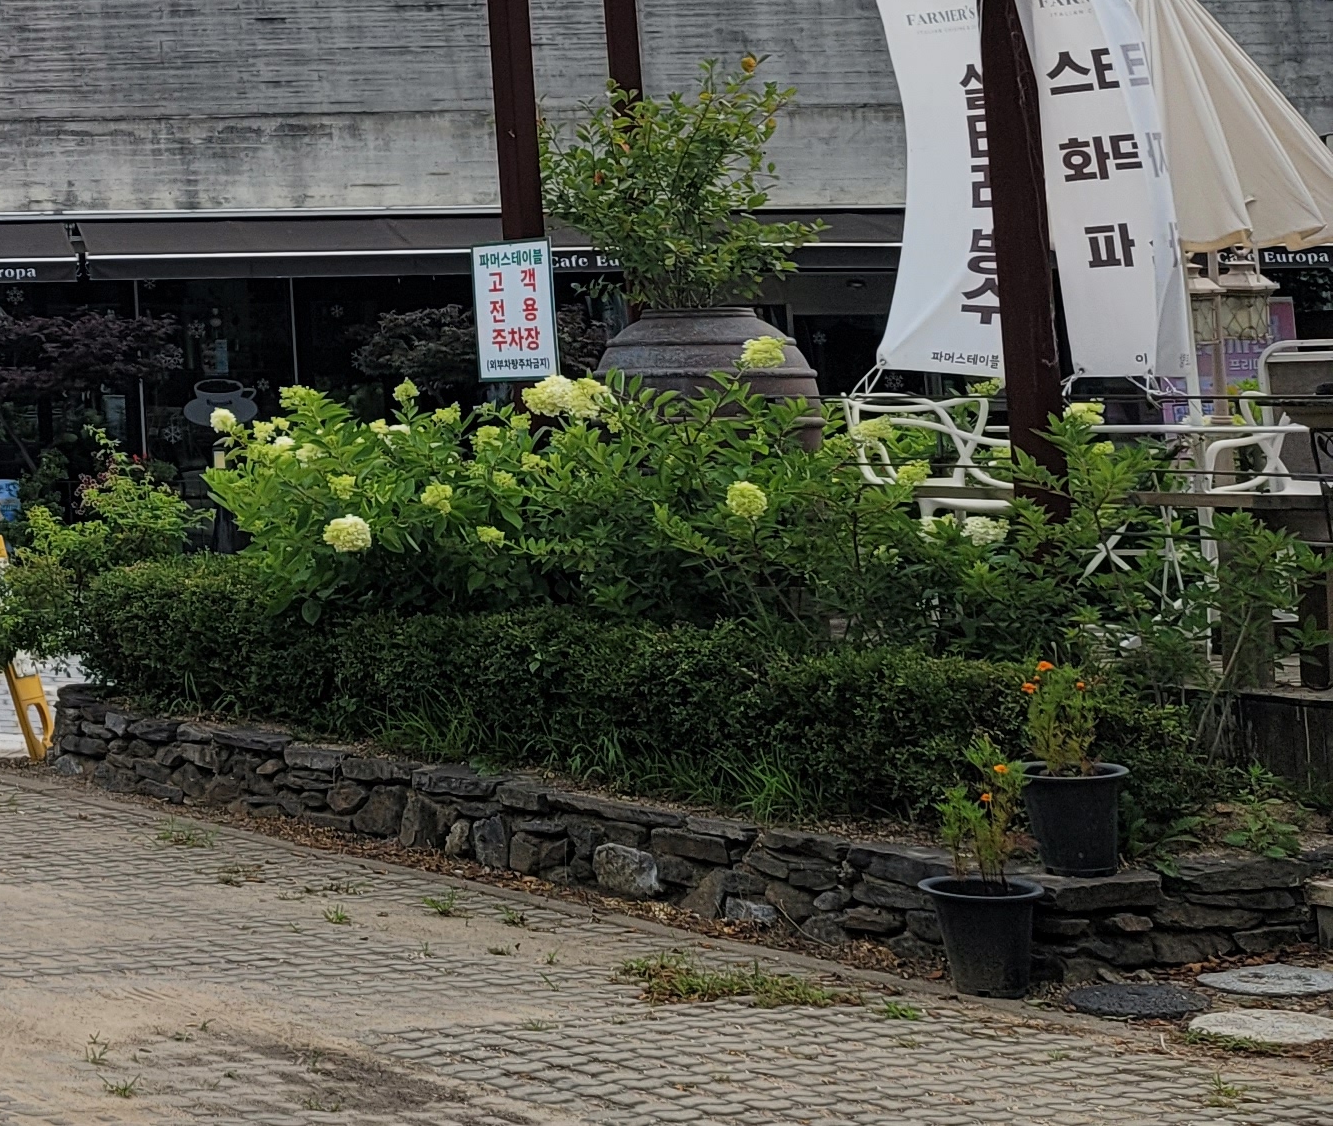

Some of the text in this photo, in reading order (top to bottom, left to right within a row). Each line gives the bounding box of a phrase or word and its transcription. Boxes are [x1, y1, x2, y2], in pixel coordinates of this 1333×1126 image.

[906, 4, 976, 27] FARMER'S
[479, 249, 543, 269] 파머스테이블
[551, 255, 589, 268] Cafe
[1264, 251, 1330, 265] Europa
[492, 326, 541, 352] 주차장
[487, 357, 550, 371] (외부차량주차금지)
[931, 350, 1001, 370] 파머스테이블
